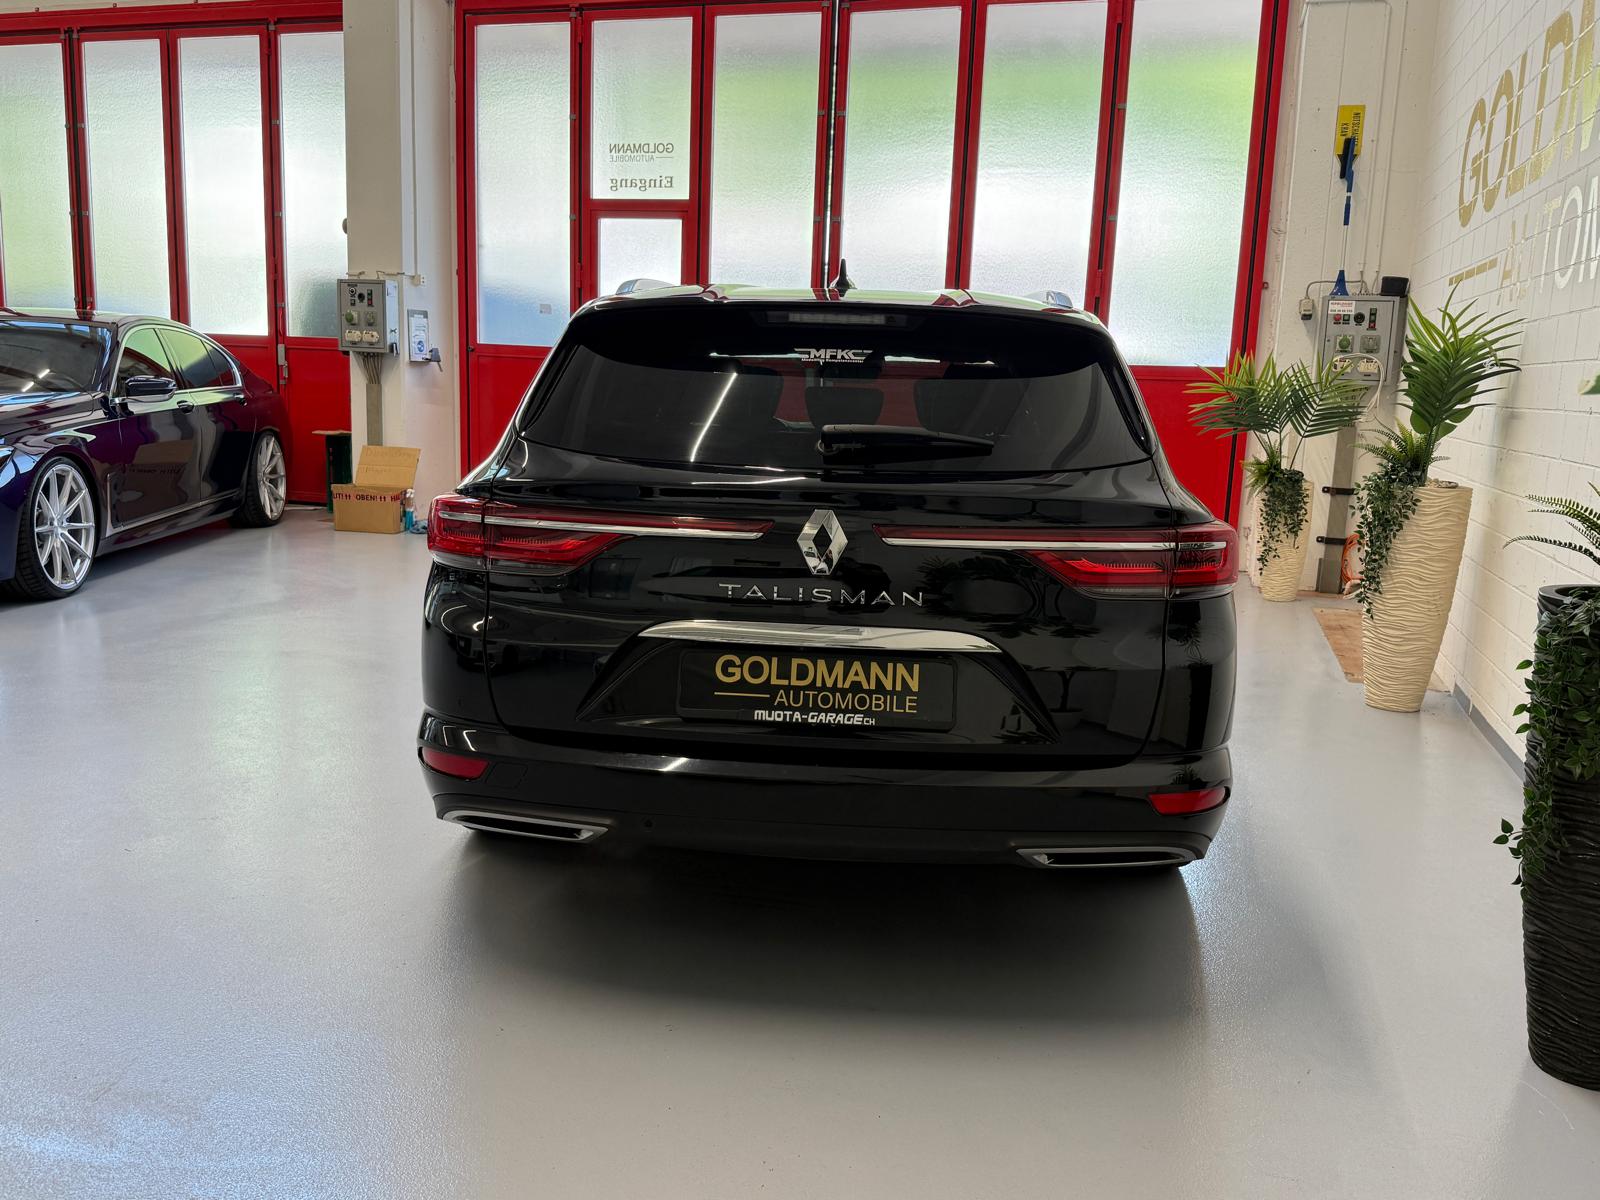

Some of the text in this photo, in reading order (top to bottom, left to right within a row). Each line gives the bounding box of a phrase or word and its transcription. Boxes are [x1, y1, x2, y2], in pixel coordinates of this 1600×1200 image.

[719, 583, 923, 607] TALISMAN
[715, 654, 920, 692] GOLDMANN
[774, 689, 918, 713] AUTOMOBILE
